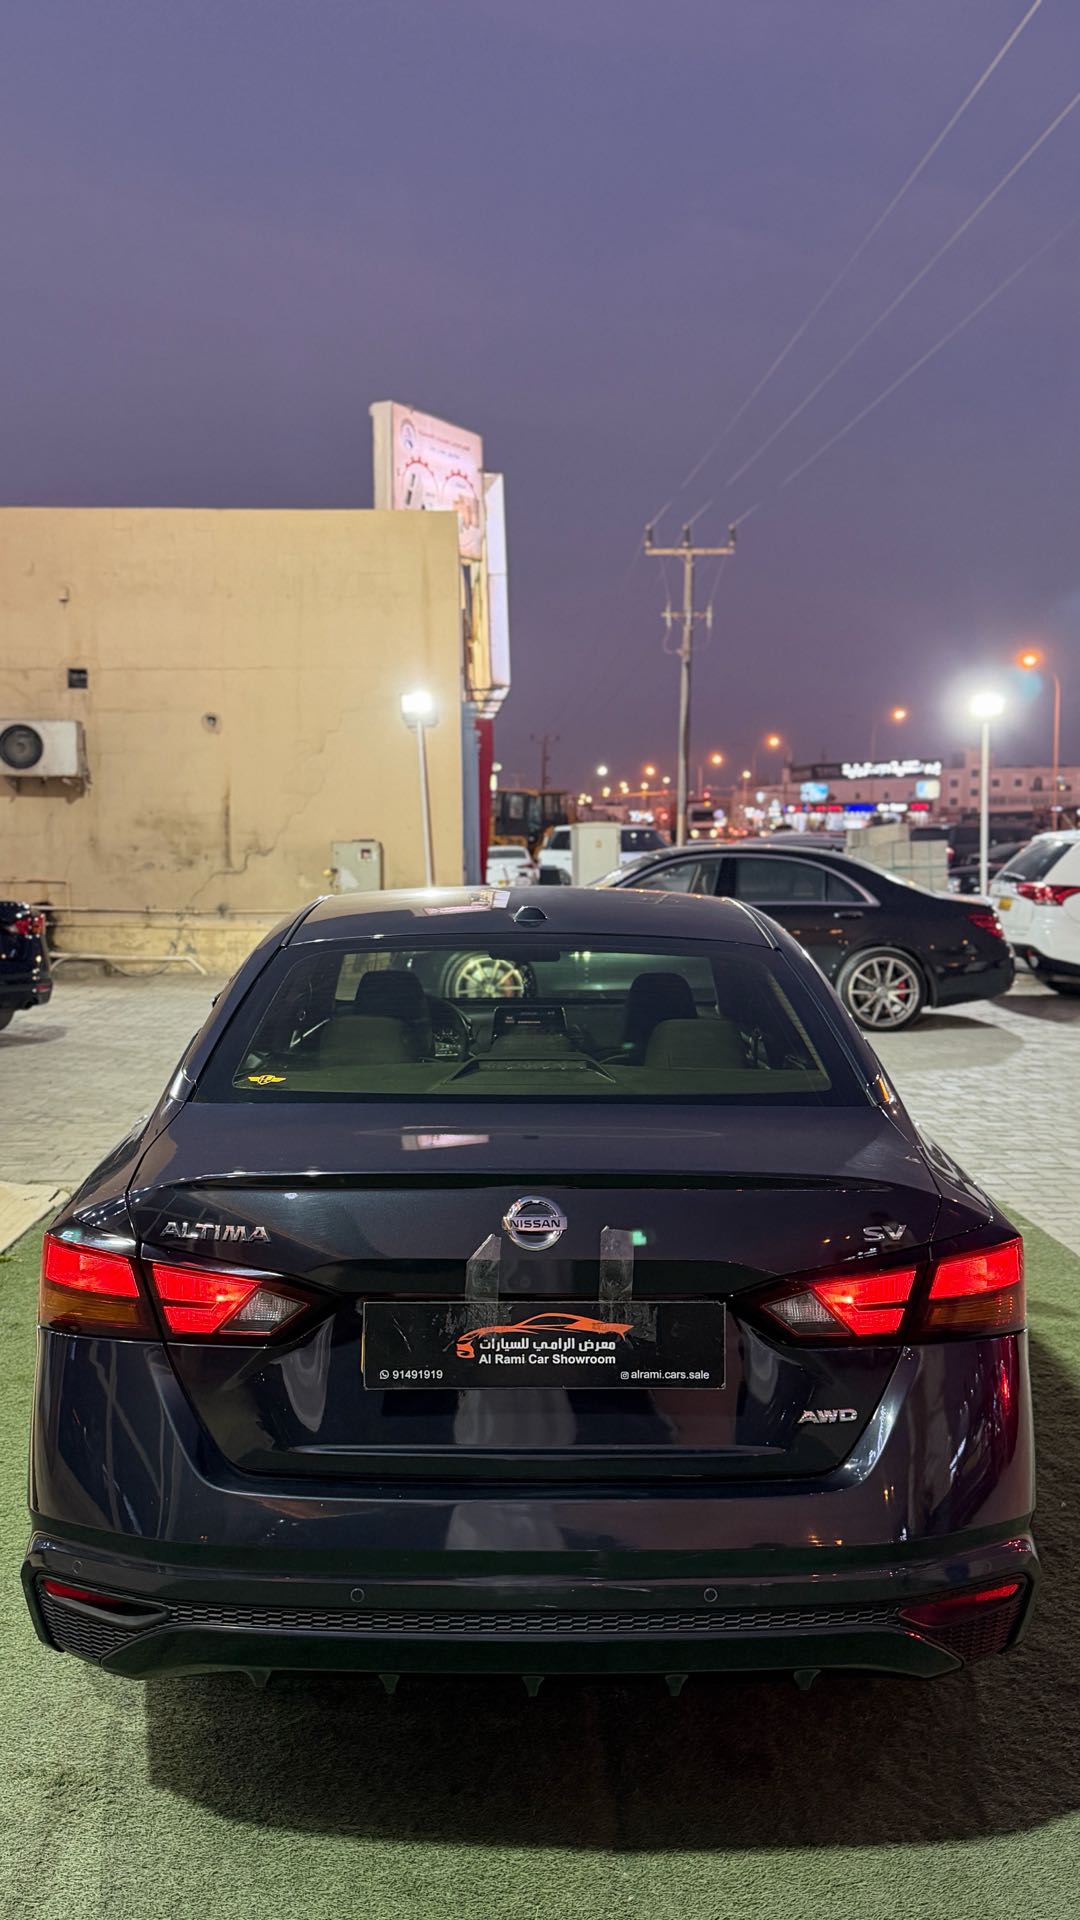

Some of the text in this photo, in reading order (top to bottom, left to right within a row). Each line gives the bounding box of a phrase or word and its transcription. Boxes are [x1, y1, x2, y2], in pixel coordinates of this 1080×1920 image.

[511, 1219, 561, 1229] NISSAN
[160, 1221, 270, 1242] ALTIMA
[863, 1224, 907, 1241] SV
[479, 1337, 616, 1352] معرض الرامي للسيارات
[479, 1353, 616, 1364] Al Rami Car Showroom
[392, 1369, 443, 1379] 91491919
[631, 1369, 710, 1379] alrami.cars.sale
[798, 1408, 858, 1424] AWD
